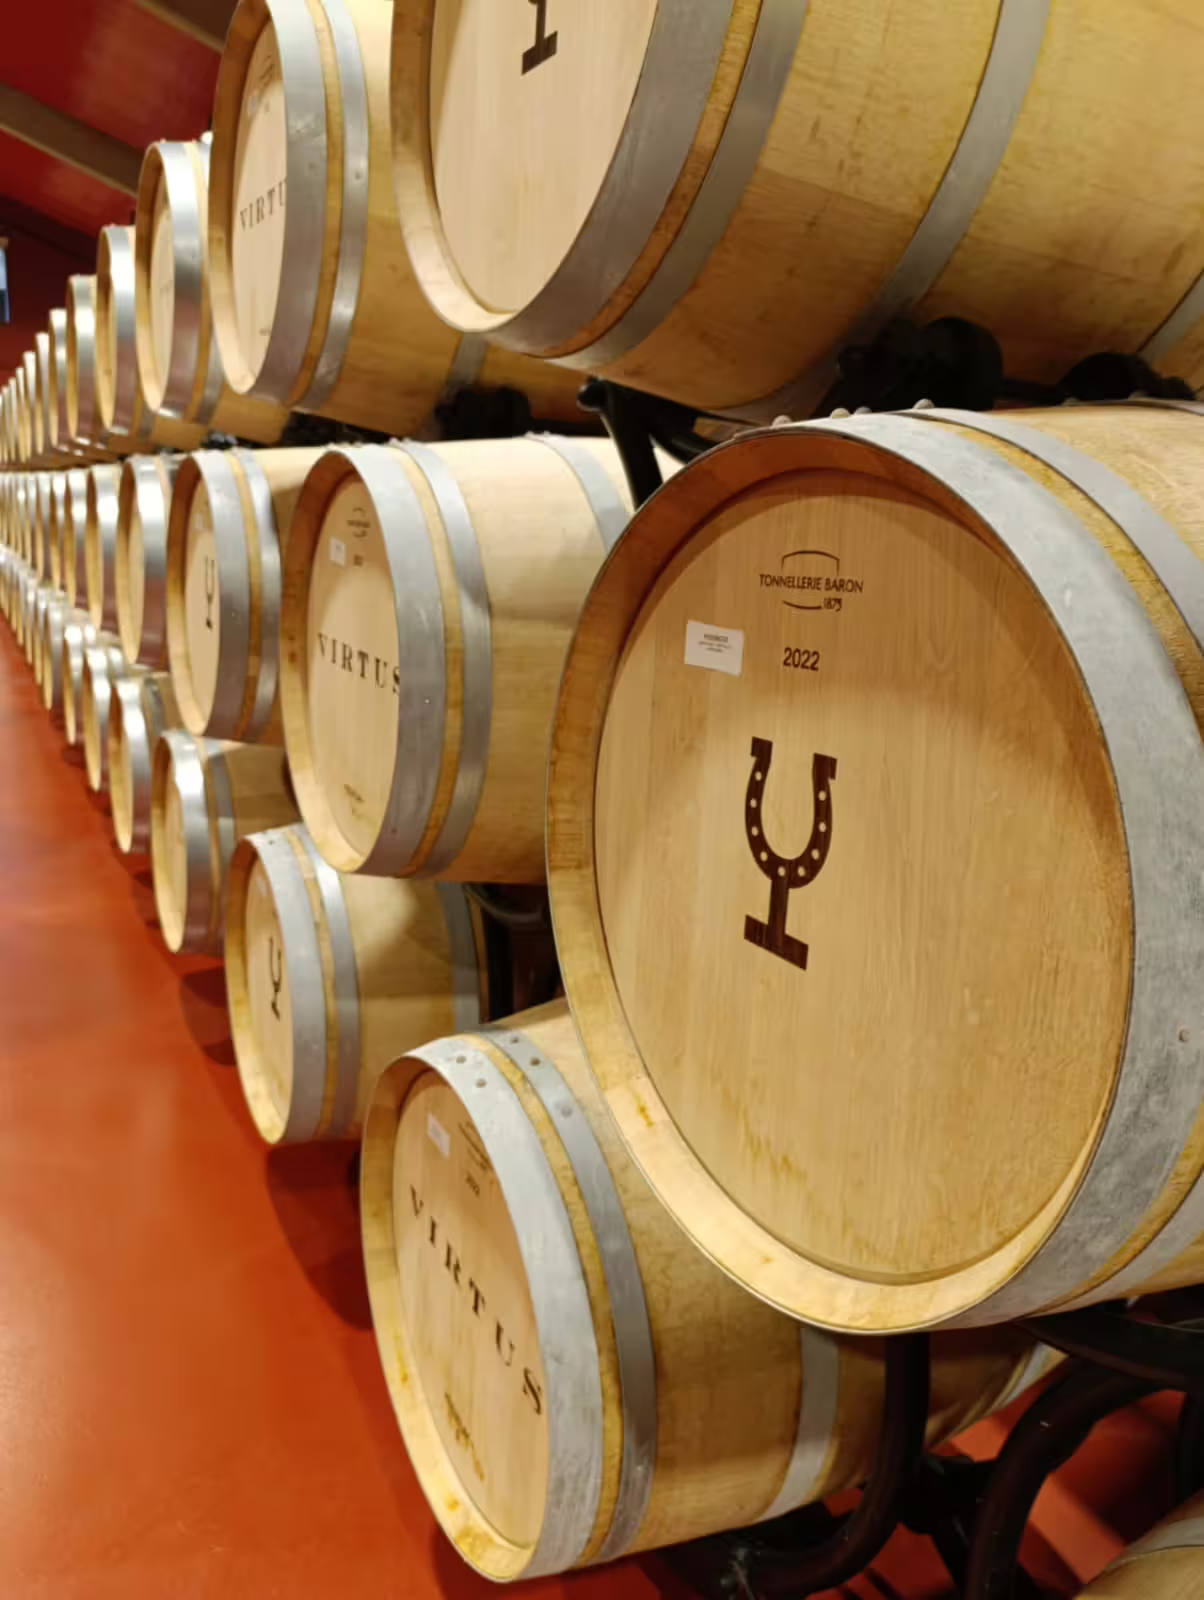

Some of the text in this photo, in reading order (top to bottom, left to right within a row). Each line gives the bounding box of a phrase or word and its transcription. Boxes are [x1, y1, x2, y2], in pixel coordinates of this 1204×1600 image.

[759, 573, 863, 593] TONNELLERIE BARON
[318, 632, 400, 697] VIRTUS
[783, 646, 820, 671] 2022
[410, 1184, 542, 1416] VIRTUS
